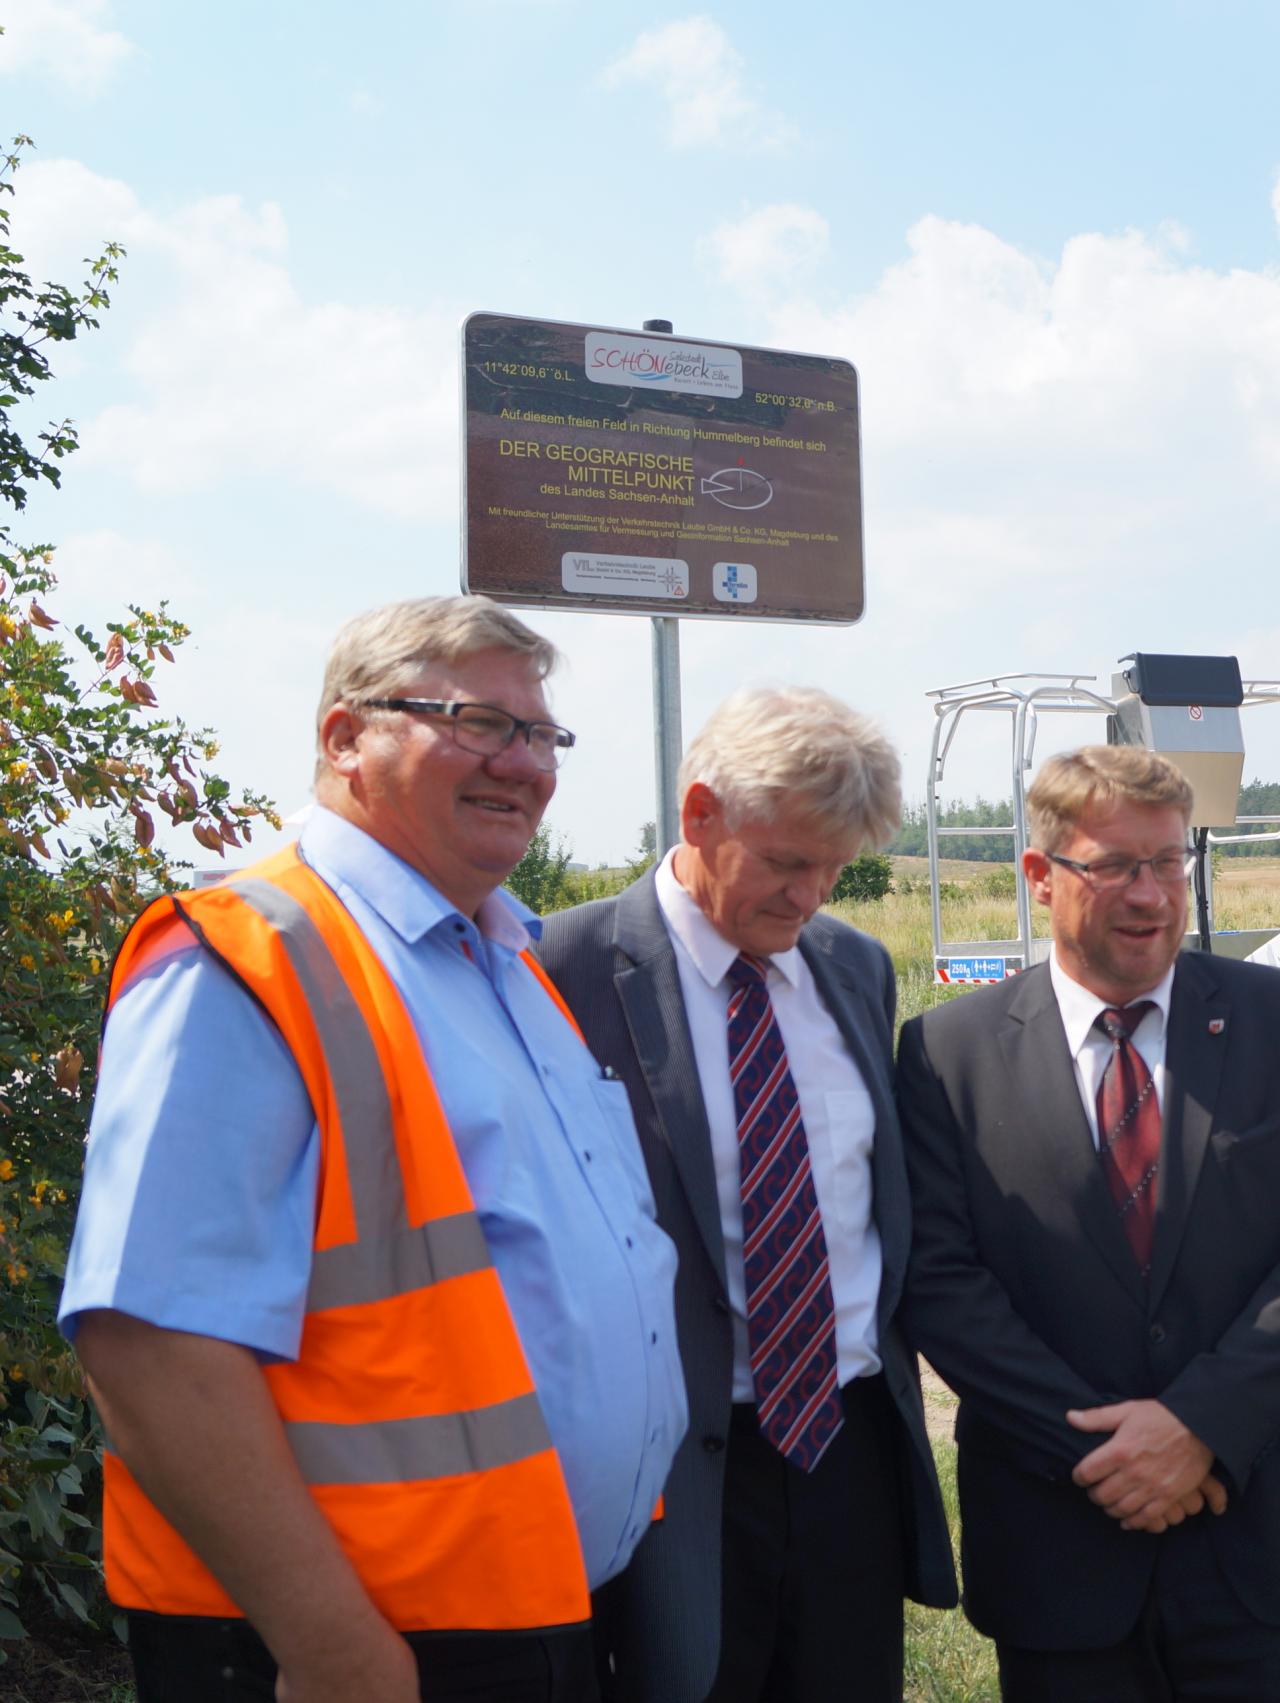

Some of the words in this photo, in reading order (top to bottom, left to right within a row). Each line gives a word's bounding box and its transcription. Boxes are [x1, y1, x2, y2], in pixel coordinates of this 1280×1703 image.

[591, 348, 709, 380] SCHÖNebeck
[500, 408, 522, 421] Auf
[523, 412, 565, 425] diesem
[567, 415, 599, 428] freien
[603, 418, 627, 431] Feld
[629, 422, 640, 432] in
[643, 423, 690, 440] Richtung
[694, 428, 760, 447] Hummelberg
[763, 436, 804, 450] befindet
[806, 440, 826, 451] sich
[500, 440, 540, 459] DER
[545, 444, 694, 473] GEOGRAFISCHE
[568, 465, 695, 492] MITTELPUNKT
[540, 483, 561, 495] des
[564, 484, 606, 499] Landes
[608, 489, 695, 507] Sachsen-Anhalt
